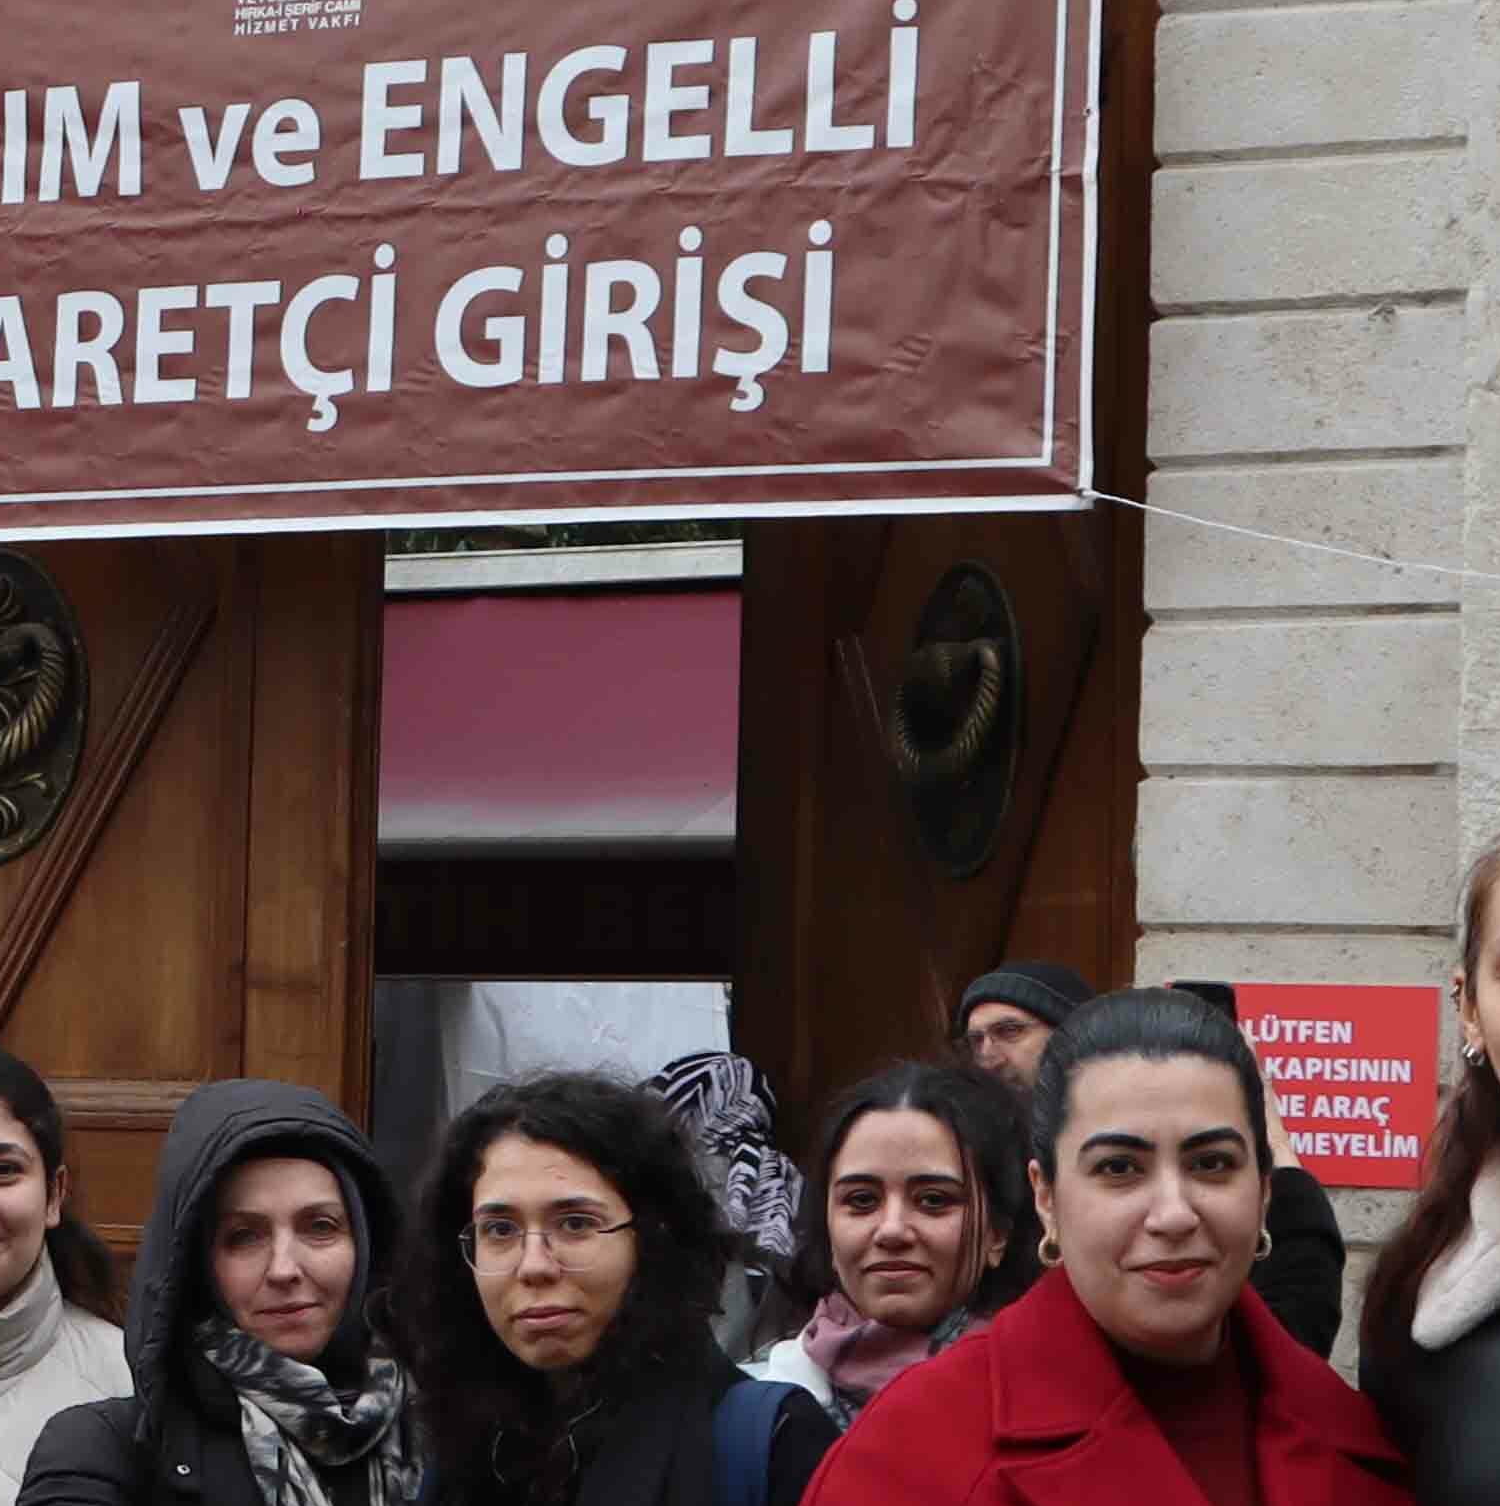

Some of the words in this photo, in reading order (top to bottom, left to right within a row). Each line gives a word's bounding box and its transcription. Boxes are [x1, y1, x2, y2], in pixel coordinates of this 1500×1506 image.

[233, 18, 299, 36] HİZMET
[307, 13, 360, 30] VAKFI
[178, 97, 322, 191] ve
[434, 219, 833, 413] GİRİŞİ
[1246, 1014, 1353, 1044] LÜTFEN
[1264, 1056, 1411, 1084] KAPISININ
[1312, 1095, 1390, 1127] ARAÇ
